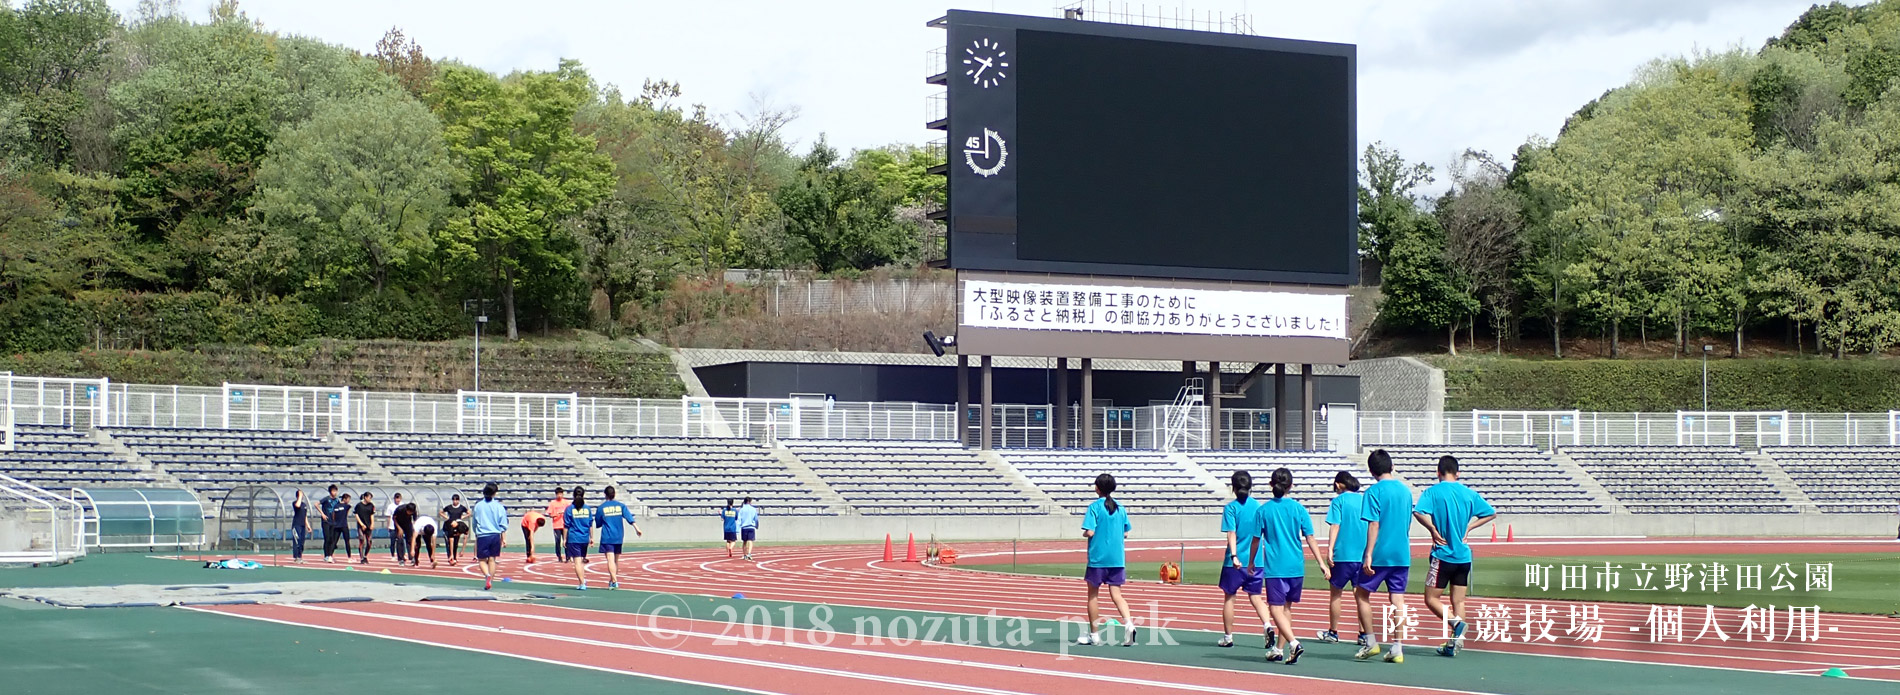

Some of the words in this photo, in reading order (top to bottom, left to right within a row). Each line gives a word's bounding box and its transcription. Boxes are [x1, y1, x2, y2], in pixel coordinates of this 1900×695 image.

[966, 136, 980, 149] 45
[972, 287, 1196, 310] 大型映像装置整備工事のために
